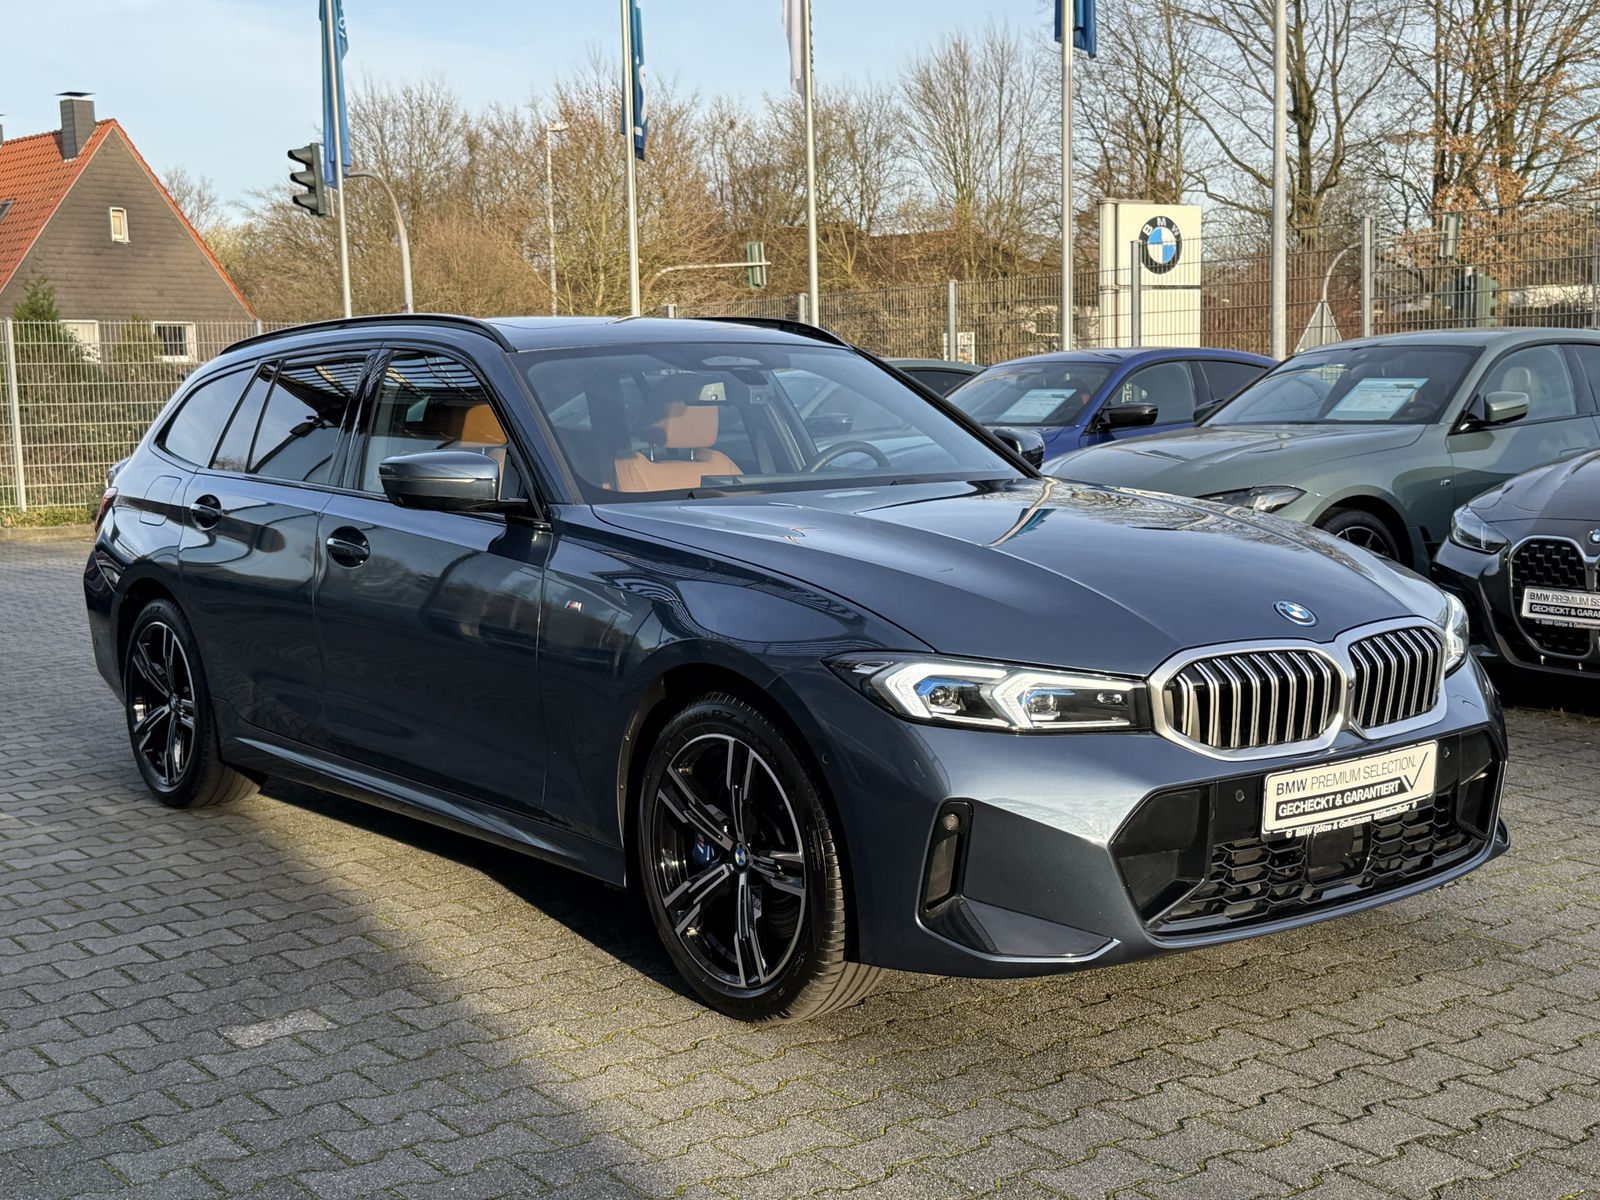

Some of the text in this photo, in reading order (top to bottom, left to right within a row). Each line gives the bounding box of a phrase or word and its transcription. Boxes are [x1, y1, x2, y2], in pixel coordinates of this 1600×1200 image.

[1143, 217, 1180, 236] BMW
[1530, 592, 1550, 601] BMW
[1552, 594, 1588, 606] PREMIUM
[1532, 604, 1570, 615] GECHECKT
[1276, 778, 1307, 796] BMW
[1311, 768, 1361, 790] PREMIUM
[1278, 780, 1400, 817] GECHECKT & GARANTIERT
